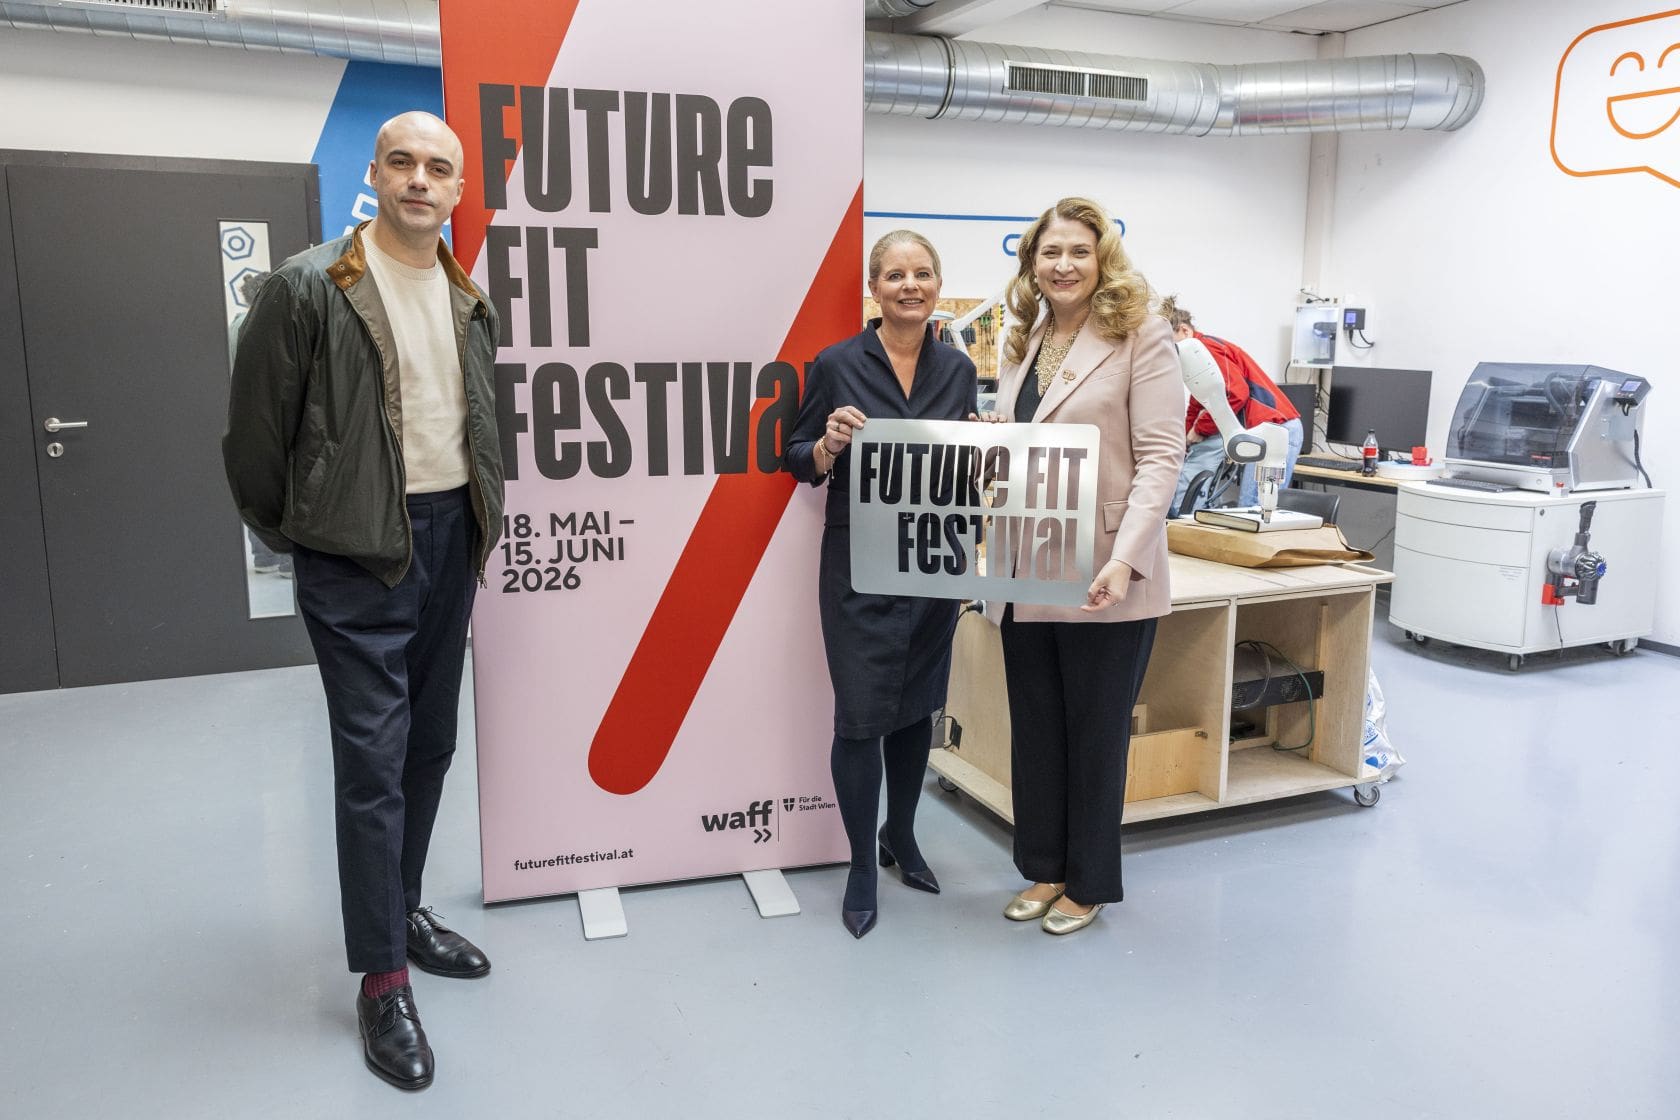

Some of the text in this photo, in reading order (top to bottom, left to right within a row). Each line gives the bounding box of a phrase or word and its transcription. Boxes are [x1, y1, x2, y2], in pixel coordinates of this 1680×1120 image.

[485, 224, 599, 348] FIT
[494, 361, 817, 481] FeSTIVa
[1024, 446, 1088, 511] FIT
[502, 513, 541, 539] 18.
[549, 511, 611, 537] MAI
[500, 537, 625, 567] 15. JUNI
[502, 565, 581, 593] 2026
[798, 795, 822, 804] Für die
[798, 801, 837, 812] Stadt Wien
[701, 799, 774, 833] waff
[513, 848, 635, 871] futurefitfestival.at
